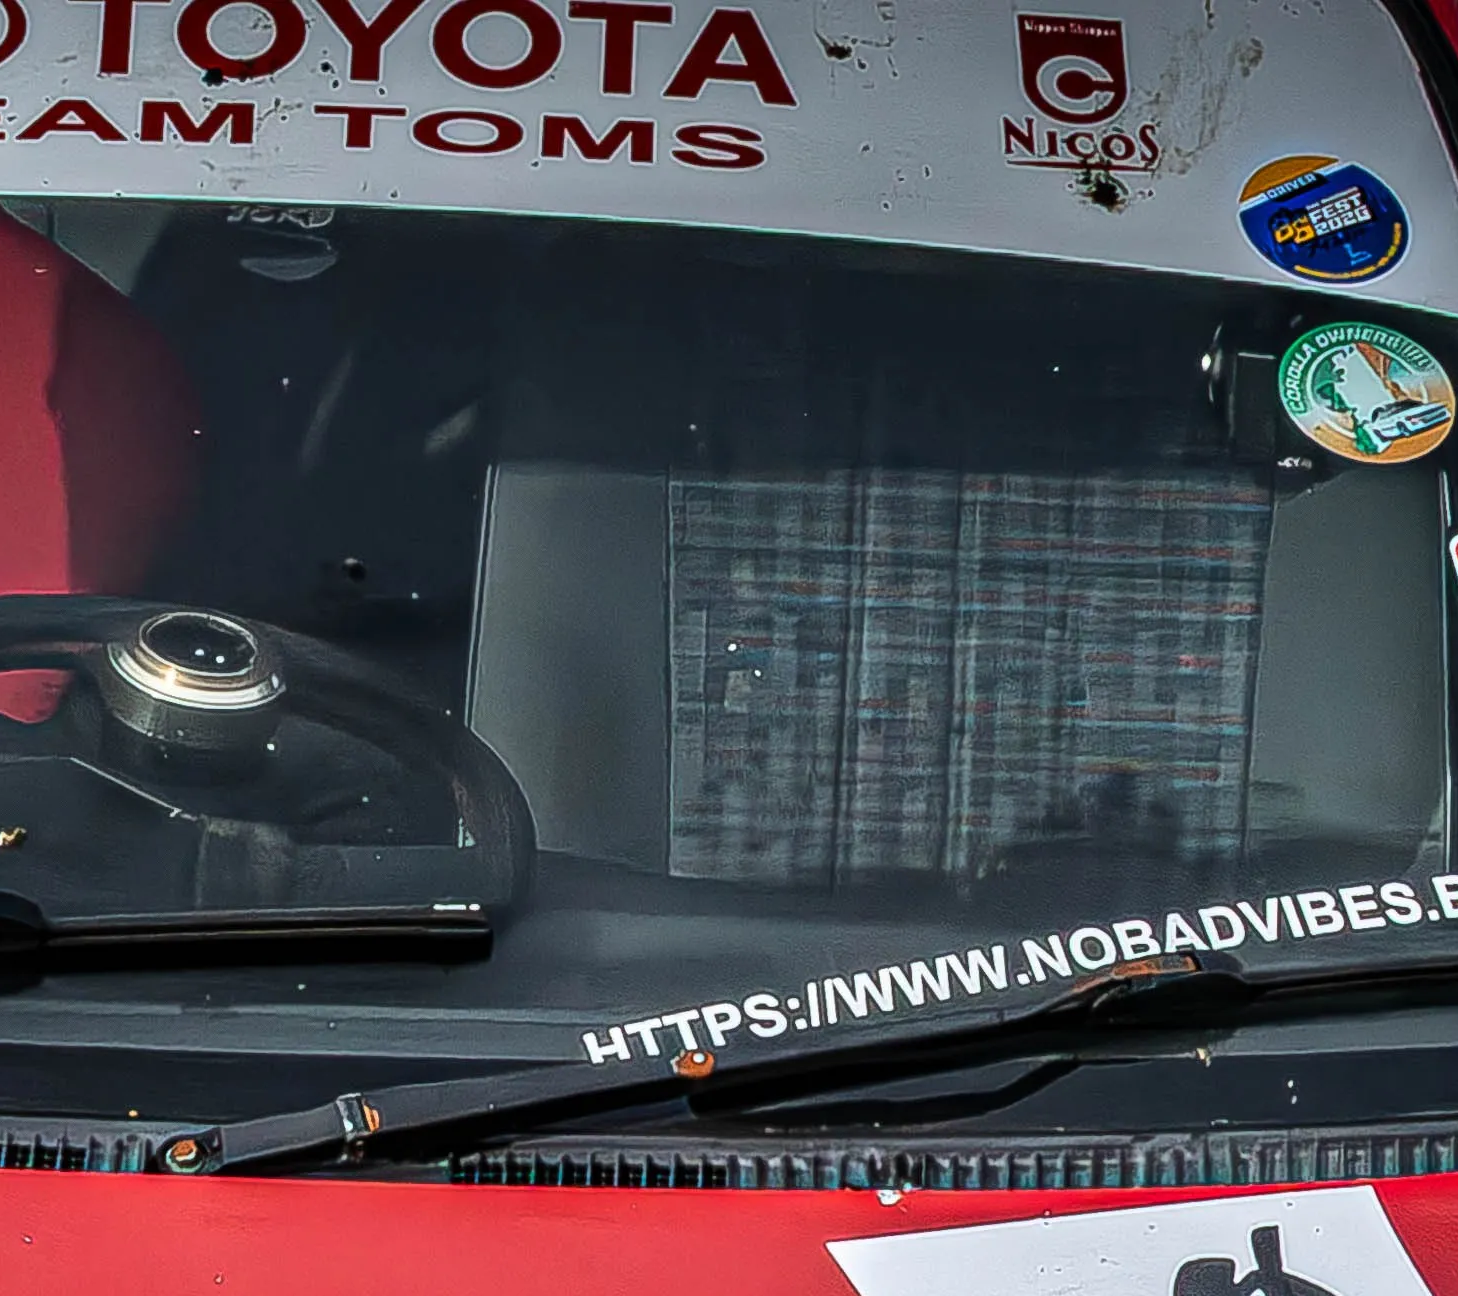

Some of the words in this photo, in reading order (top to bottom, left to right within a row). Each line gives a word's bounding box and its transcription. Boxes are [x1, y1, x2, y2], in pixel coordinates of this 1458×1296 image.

[88, 0, 797, 107] TOYOTA
[314, 106, 766, 171] TOMS
[1002, 116, 1161, 168] NICOS
[1308, 192, 1362, 225] FEST
